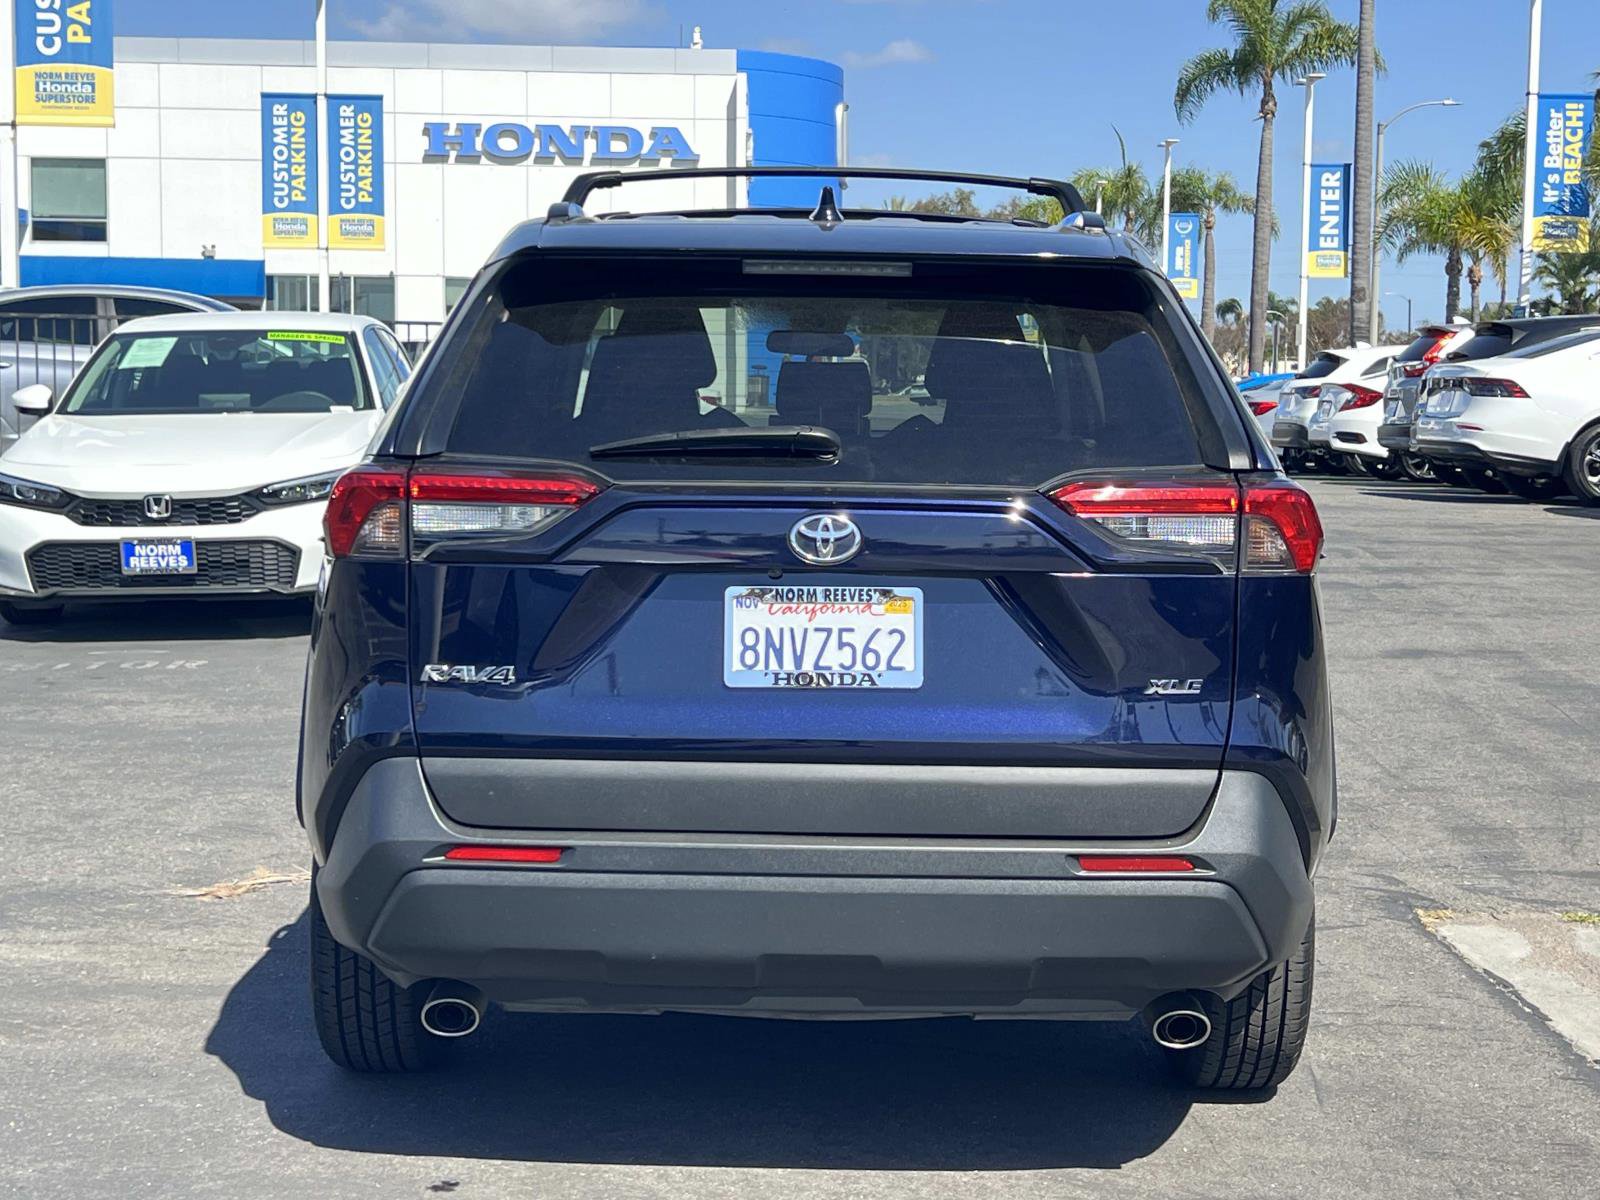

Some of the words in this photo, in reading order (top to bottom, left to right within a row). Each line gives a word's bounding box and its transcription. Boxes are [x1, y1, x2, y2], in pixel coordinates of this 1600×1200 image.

[34, 72, 63, 81] NORM
[64, 72, 96, 81] REEVES
[38, 81, 92, 93] Honda
[35, 93, 96, 104] SUPERSTORE
[422, 122, 700, 167] HONDA
[1544, 108, 1562, 169] Better
[1563, 103, 1585, 185] BEACH!
[272, 103, 289, 209] CUSTOMER
[290, 111, 306, 202] PARKING
[339, 104, 356, 210] CUSTOMER
[357, 112, 373, 203] PARKING
[1542, 173, 1560, 203] It's
[1319, 170, 1341, 248] ENTER
[129, 555, 188, 568] REEVES
[134, 544, 181, 556] NORM
[735, 597, 760, 609] NOV
[774, 588, 818, 602] NORM
[824, 588, 873, 602] REEVES
[768, 603, 886, 622] California
[739, 626, 906, 671] 8NVZ562
[420, 664, 516, 685] RAV4
[1144, 679, 1204, 694] XLE
